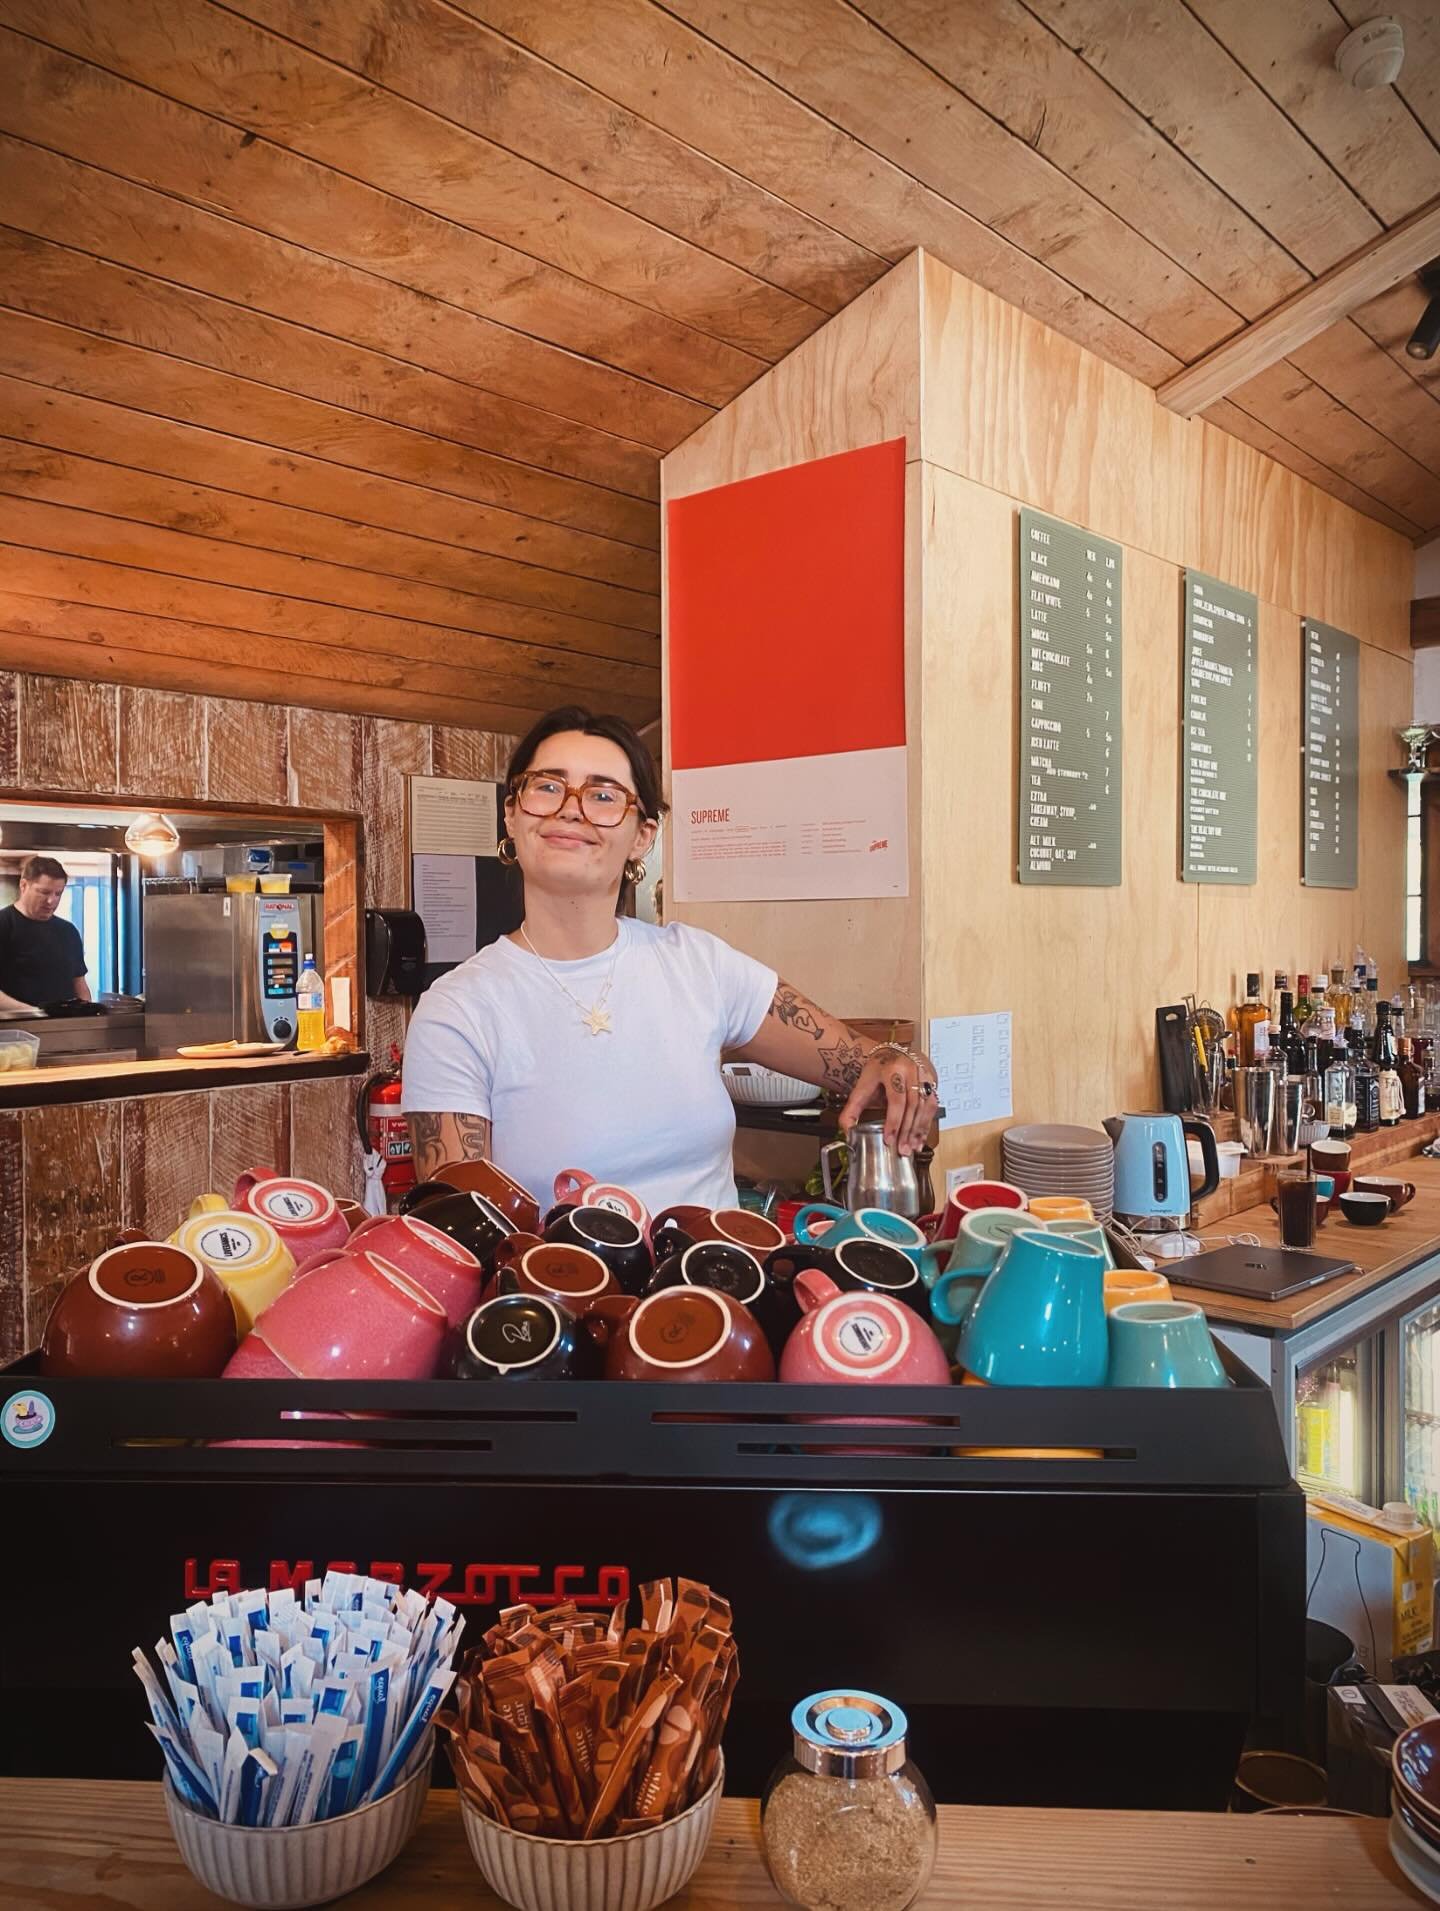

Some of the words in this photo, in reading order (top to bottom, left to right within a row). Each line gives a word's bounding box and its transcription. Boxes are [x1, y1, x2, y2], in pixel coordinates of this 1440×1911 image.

[1030, 528, 1050, 545] COFFEE
[1030, 552, 1048, 567] BLACK
[1030, 570, 1060, 590] AMERICANO
[1030, 590, 1045, 605] FLAT
[1045, 594, 1062, 609] WHITE
[1030, 608, 1048, 623] LATTE
[1031, 648, 1043, 661] HOT
[1043, 650, 1070, 667] CHOCOLATE
[1031, 680, 1051, 694] FLUFFY
[1031, 698, 1044, 711] CHAI
[1031, 717, 1062, 733] CAPPUCCINO
[1030, 736, 1044, 749] ICED
[1044, 738, 1060, 751] LATTE
[1030, 756, 1052, 769] MATCHA
[1032, 775, 1041, 786] TEA
[1030, 791, 1048, 802] EXTRA
[690, 808, 730, 824] SUPREME
[1030, 817, 1048, 828] CREAM
[1030, 836, 1040, 846] ALT
[1042, 836, 1056, 847] MILK
[1067, 850, 1076, 860] SOY
[1030, 860, 1052, 872] ALMOND
[184, 1558, 241, 1602] LA
